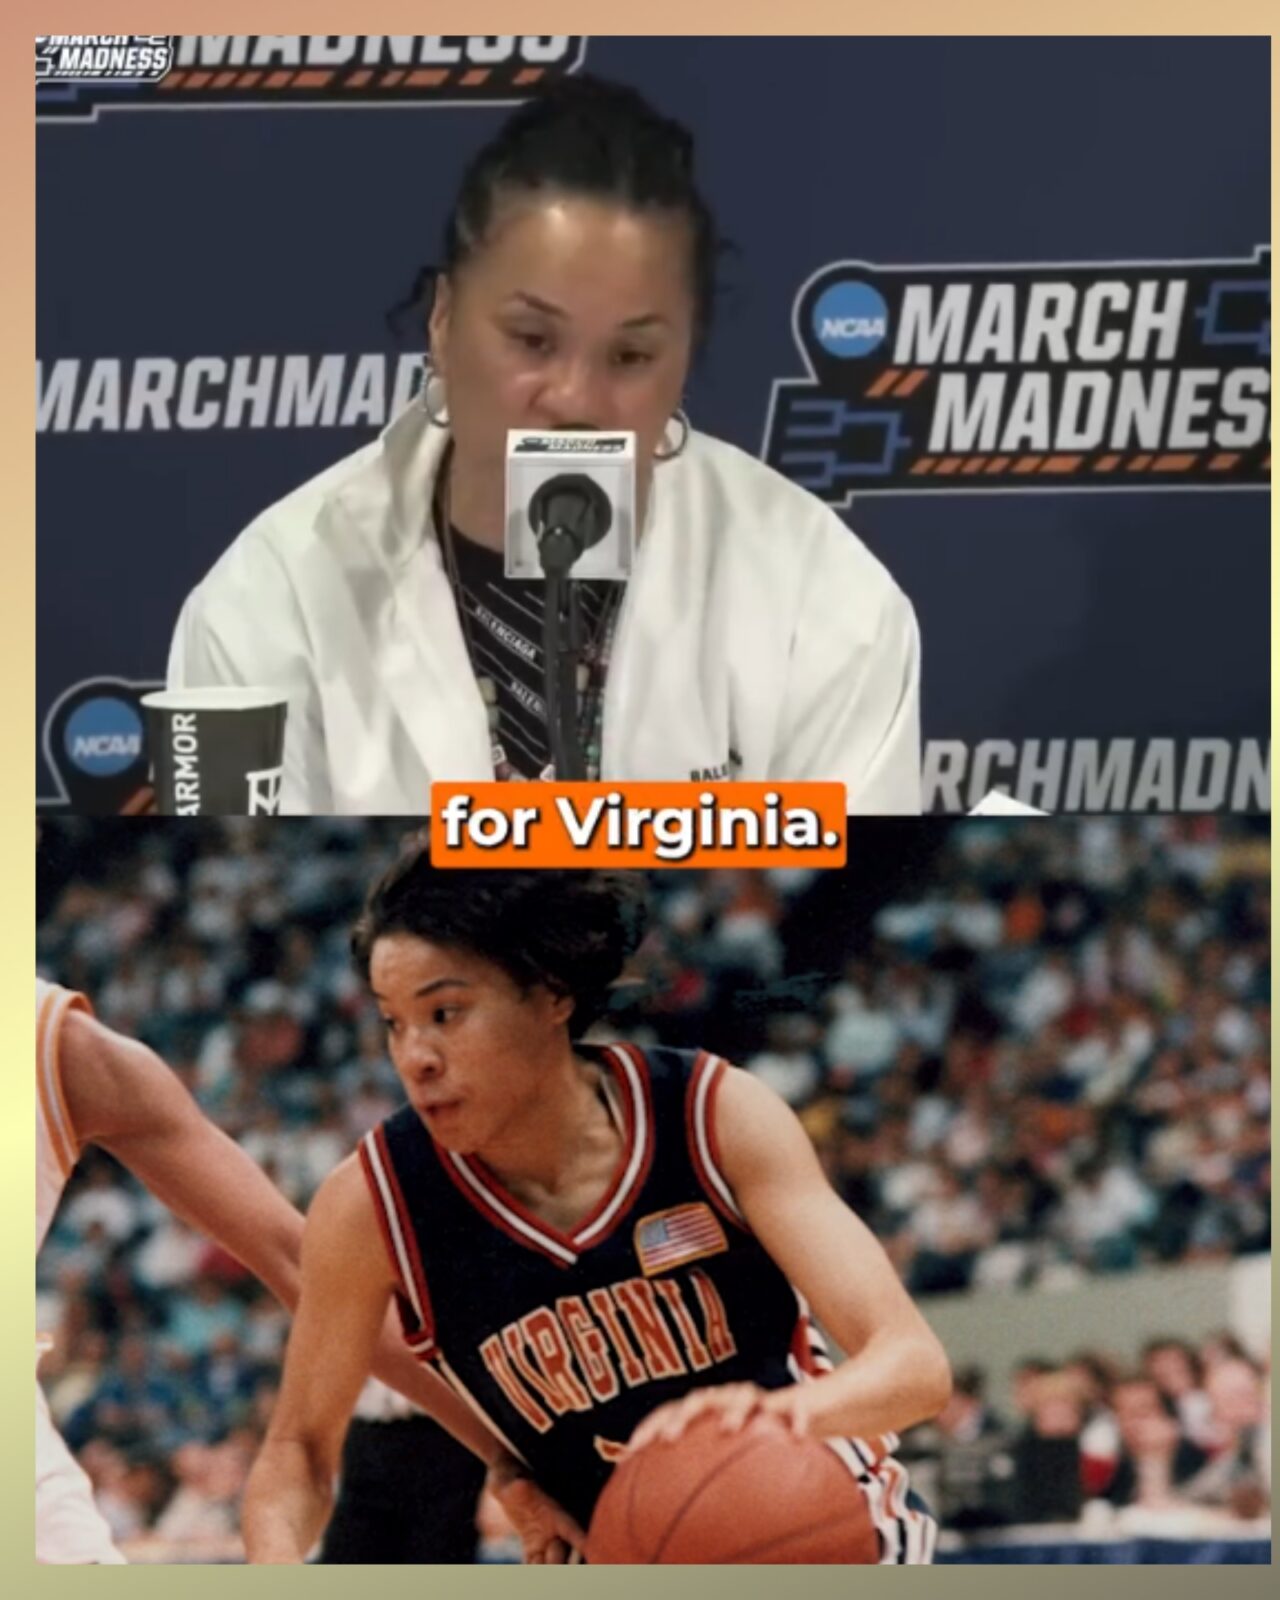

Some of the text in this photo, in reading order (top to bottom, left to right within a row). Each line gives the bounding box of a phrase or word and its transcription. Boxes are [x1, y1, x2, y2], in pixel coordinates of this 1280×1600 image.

[821, 315, 885, 339] NCAA
[893, 280, 1188, 365] MARCH
[927, 367, 1271, 452] MADNES
[478, 1268, 738, 1434] VIRGINIA
